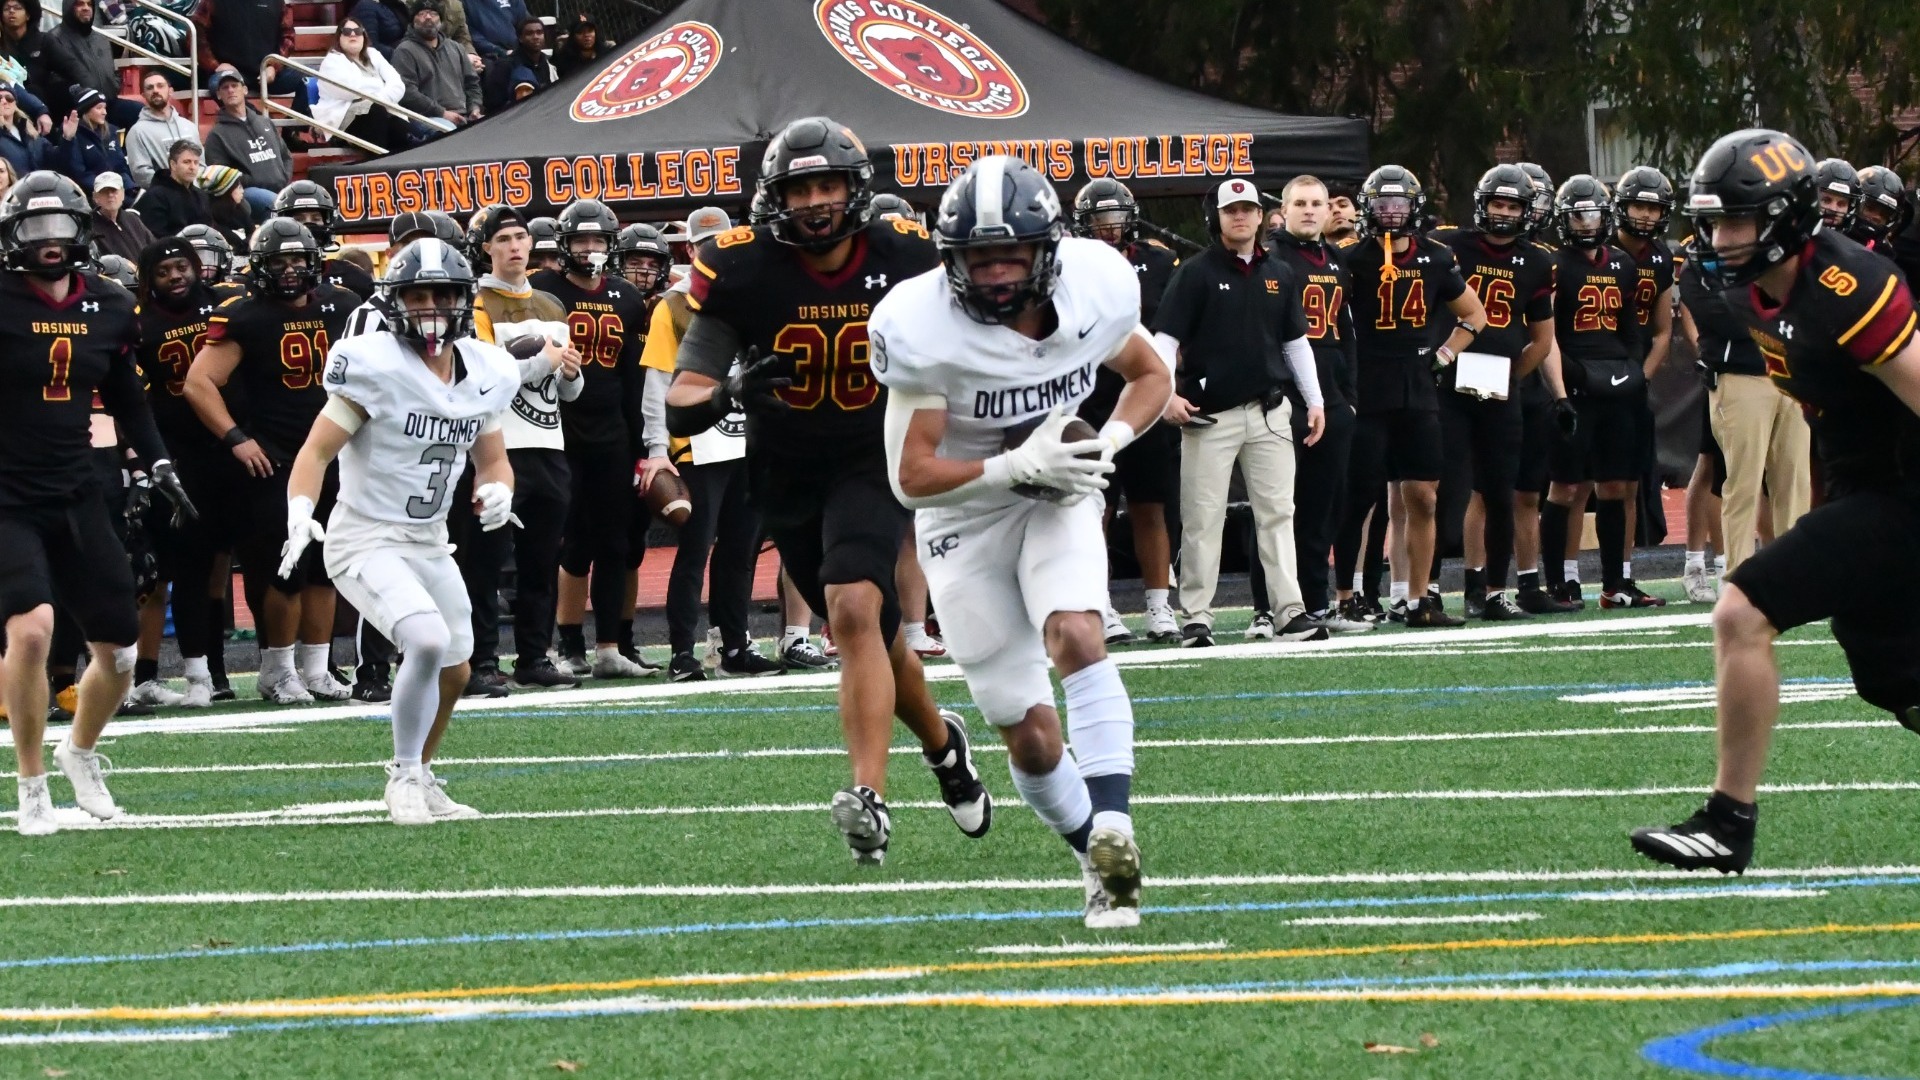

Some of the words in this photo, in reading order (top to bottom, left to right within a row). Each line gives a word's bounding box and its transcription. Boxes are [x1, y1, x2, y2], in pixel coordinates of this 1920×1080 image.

[678, 29, 711, 83] COLLEGE
[829, 0, 878, 71] URSINUS
[869, 0, 997, 72] COLLEGE
[893, 82, 1013, 112] ATHLETICS
[1084, 133, 1254, 179] COLLEGE
[1751, 142, 1805, 183] UC
[334, 161, 532, 222] URSINUS
[544, 146, 741, 206] COLLEGE
[1264, 279, 1279, 290] UC
[1308, 275, 1338, 284] URSINUS
[1475, 265, 1514, 279] URSINUS
[1586, 275, 1616, 285] URSINUS
[1819, 265, 1858, 296] 5
[575, 301, 614, 313] URSINUS
[798, 304, 870, 320] URSINUS
[1375, 279, 1427, 330] 14
[1466, 274, 1516, 328] 16
[1574, 285, 1623, 332] 29
[32, 321, 88, 336] URSINUS
[164, 322, 208, 340] URSINUS
[283, 320, 325, 332] URSINUS
[568, 312, 625, 369] 96
[43, 337, 72, 401] 1
[158, 333, 208, 397] 3
[280, 329, 329, 389] 91
[326, 354, 349, 385] 3
[772, 321, 880, 411] 38
[973, 361, 1092, 419] DUTCHMEN
[404, 412, 486, 444] DUTCHMEN
[406, 444, 457, 520] 3
